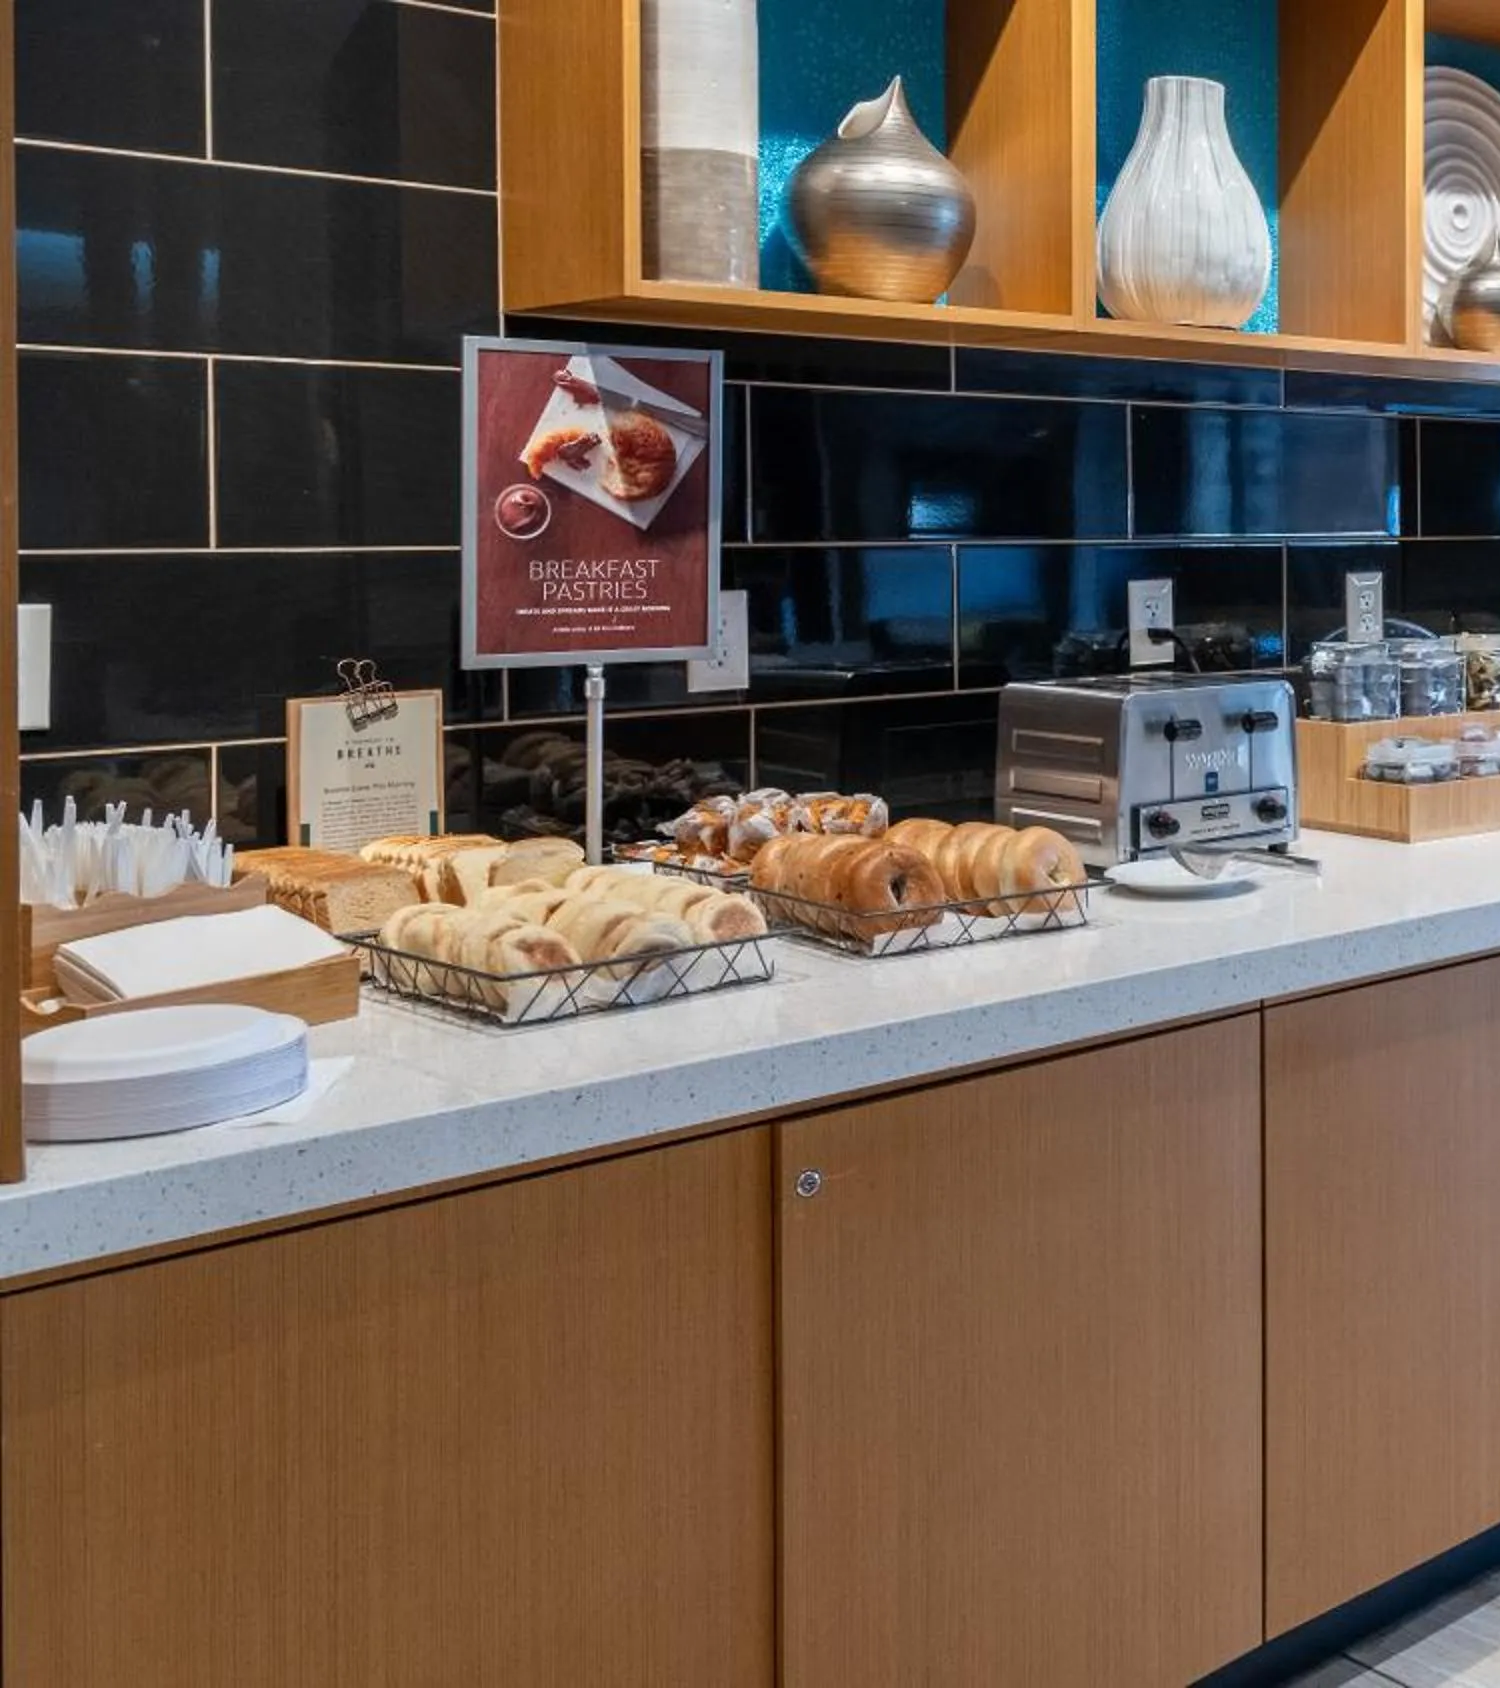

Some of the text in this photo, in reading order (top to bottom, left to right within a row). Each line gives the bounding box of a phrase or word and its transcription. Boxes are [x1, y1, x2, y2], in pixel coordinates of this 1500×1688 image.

[528, 558, 660, 581] BREAKFAST
[542, 579, 648, 602] PASTRIES
[336, 744, 401, 761] BREATHE
